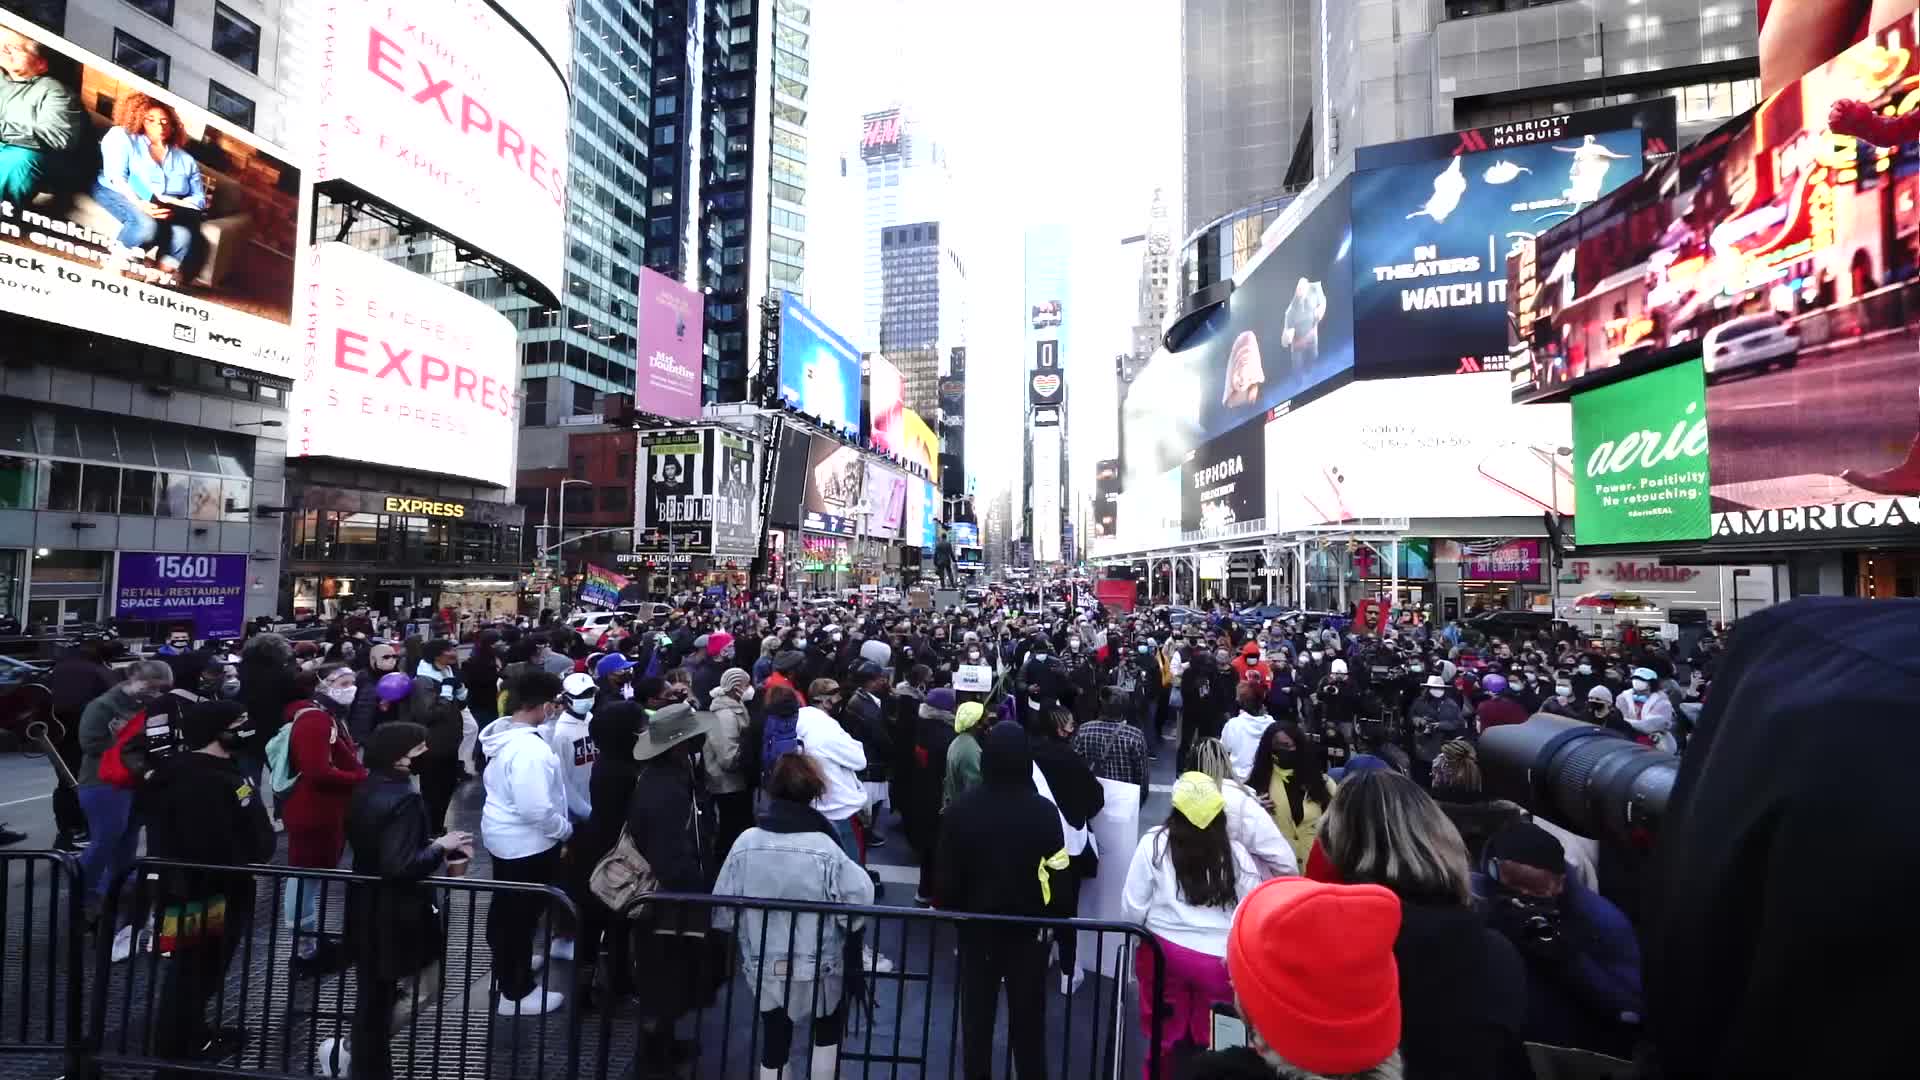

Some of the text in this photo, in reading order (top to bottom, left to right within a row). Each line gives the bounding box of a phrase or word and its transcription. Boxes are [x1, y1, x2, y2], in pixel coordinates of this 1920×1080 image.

[367, 25, 570, 207] EXPRES
[1494, 116, 1570, 135] MARRIOTT
[1494, 128, 1562, 146] MARQUIS
[23, 210, 118, 250] makin
[1414, 245, 1436, 261] IN
[1373, 256, 1480, 281] THEATERS
[57, 266, 82, 284] to
[92, 278, 130, 298] not
[1401, 280, 1482, 312] WATCH
[335, 327, 517, 417] EXPRES
[1194, 455, 1244, 489] SEPHORA
[386, 497, 465, 518] EXPRESS
[1623, 488, 1702, 504] retouching.
[1713, 496, 1920, 537] AMERICA
[617, 555, 692, 563] GIFTS LUGGAGE
[1257, 567, 1284, 577] SEPORA
[120, 596, 225, 609] SPACE AVAILABLE
